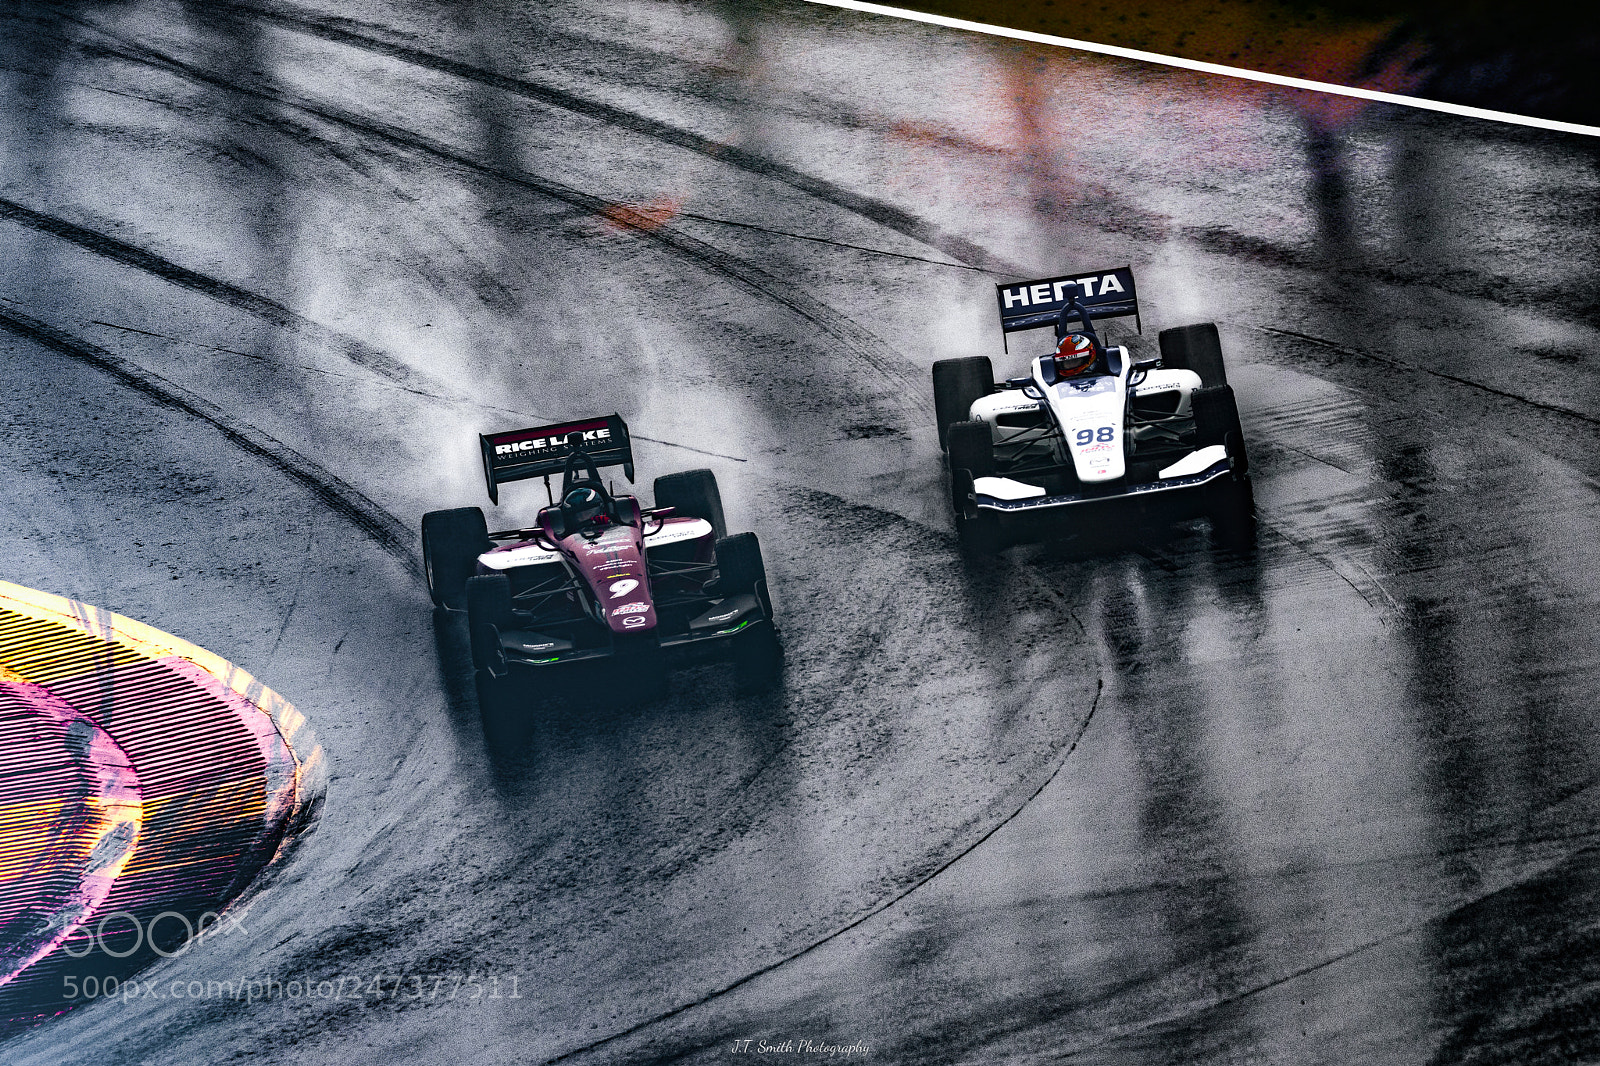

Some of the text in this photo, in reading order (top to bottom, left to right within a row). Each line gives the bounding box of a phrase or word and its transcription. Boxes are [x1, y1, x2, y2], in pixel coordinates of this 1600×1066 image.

[495, 438, 547, 455] RICE
[1076, 426, 1114, 447] 98
[497, 438, 613, 460] WEIGHING STEMS
[609, 578, 639, 599] 9
